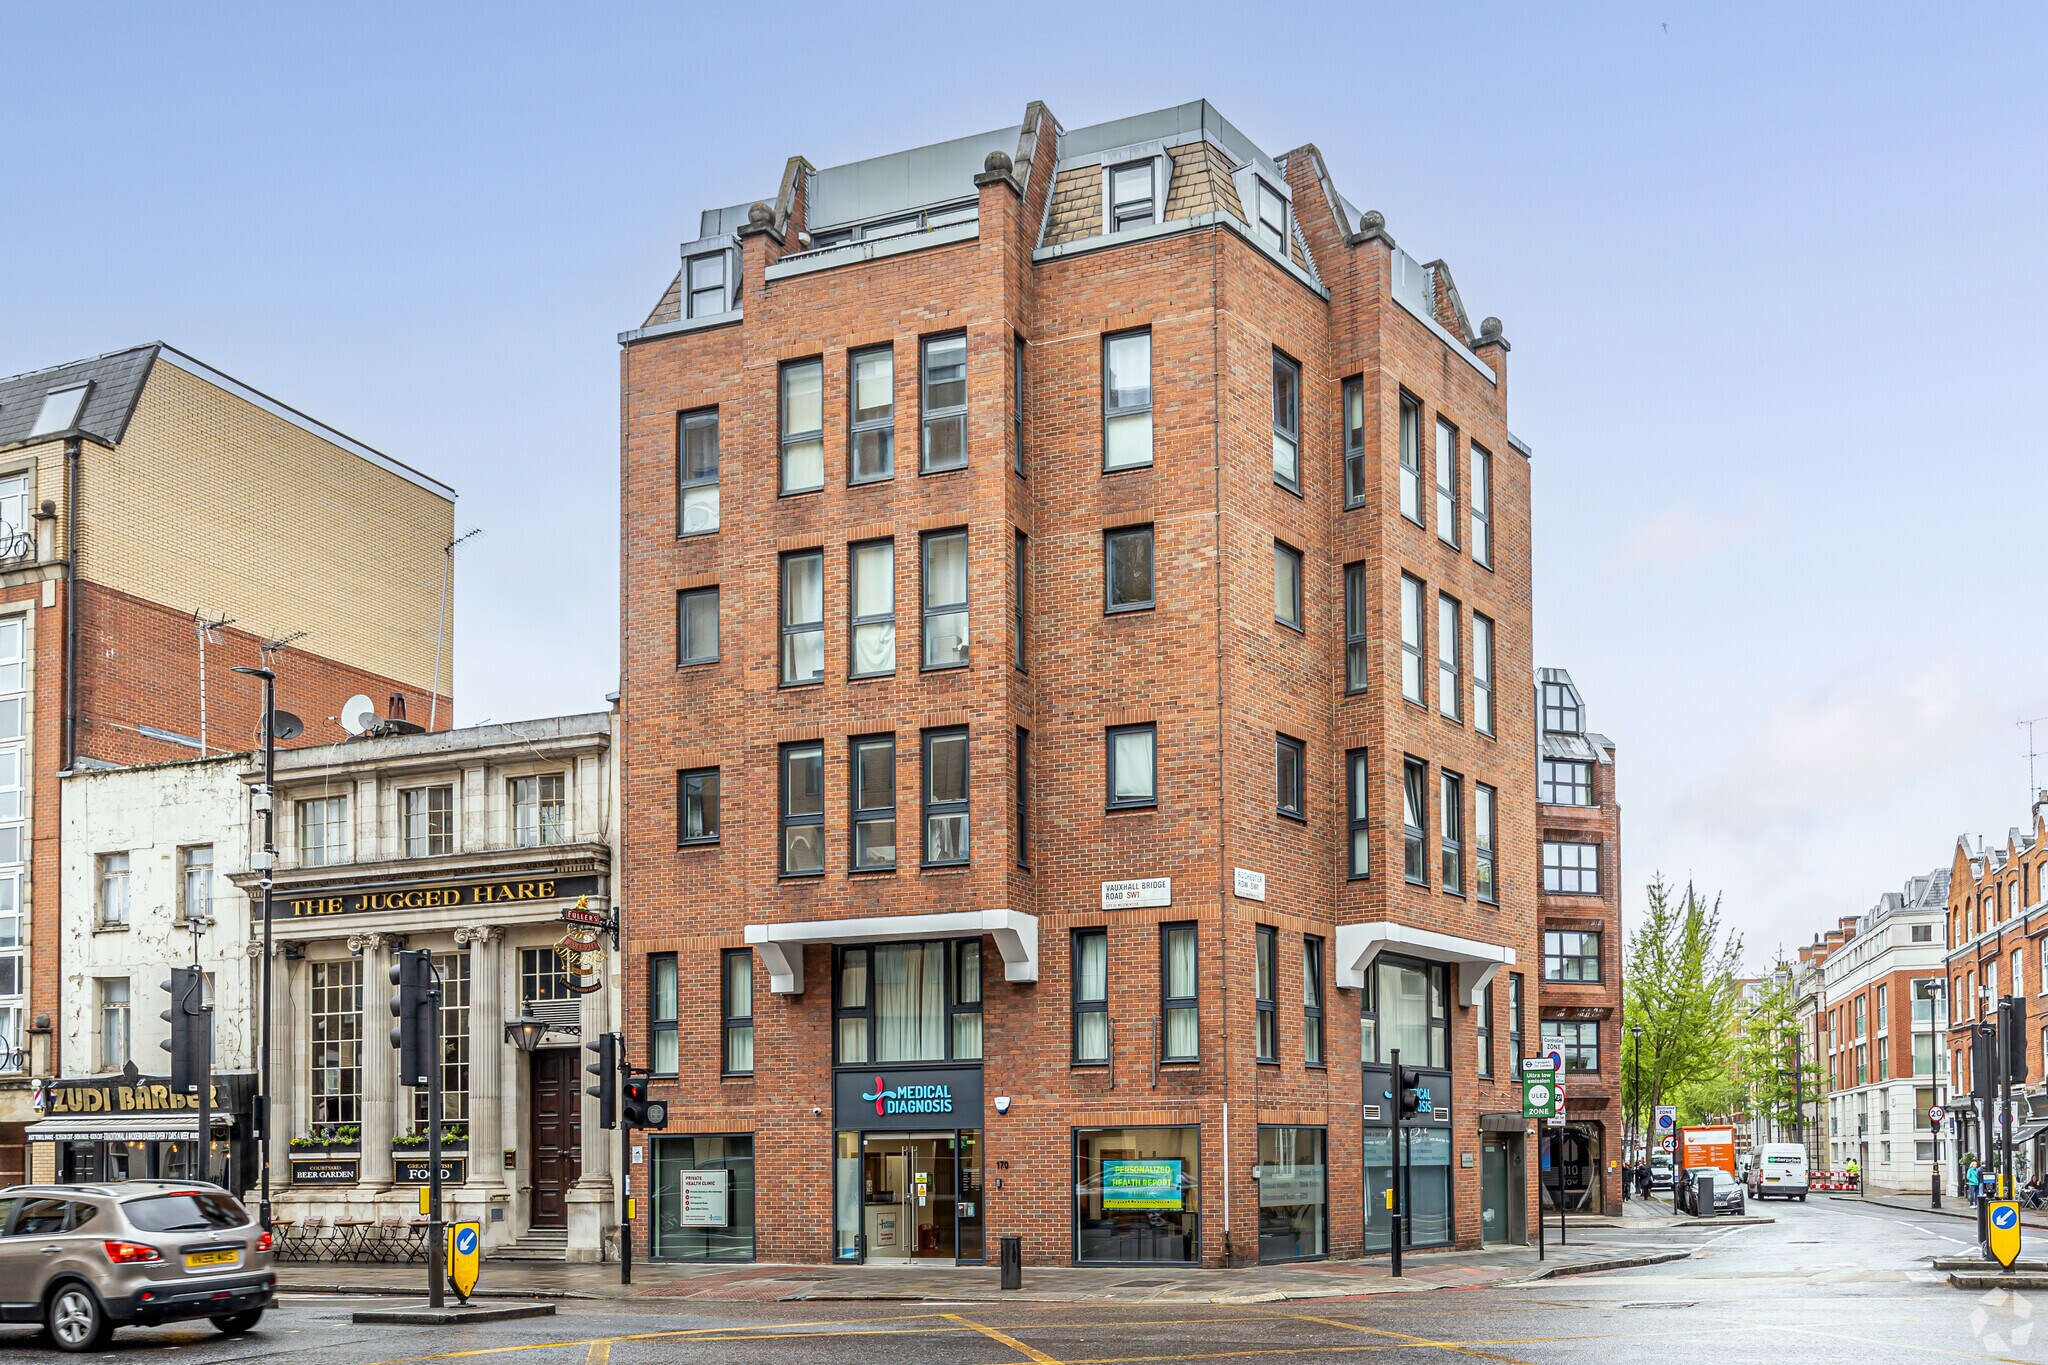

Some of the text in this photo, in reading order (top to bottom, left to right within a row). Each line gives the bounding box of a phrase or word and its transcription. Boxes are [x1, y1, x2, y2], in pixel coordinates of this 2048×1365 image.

[1105, 880, 1166, 892] VAUXHALL BRIDGE
[290, 880, 555, 917] THE JUGGED HARE
[1105, 891, 1140, 900] ROAD SW1
[897, 1084, 952, 1099] MEDICAL
[53, 1087, 112, 1113] ZUDI
[887, 1099, 953, 1114] DIAGNOSIS
[1930, 1109, 1942, 1117] 20
[1664, 1140, 1677, 1148] 20
[996, 1161, 1009, 1169] 170
[1114, 1165, 1171, 1174] PERSONALIZED
[296, 1170, 354, 1179] BEER GARDEN
[409, 1169, 450, 1180] FOD
[1112, 1178, 1172, 1187] HEALTH REPORT
